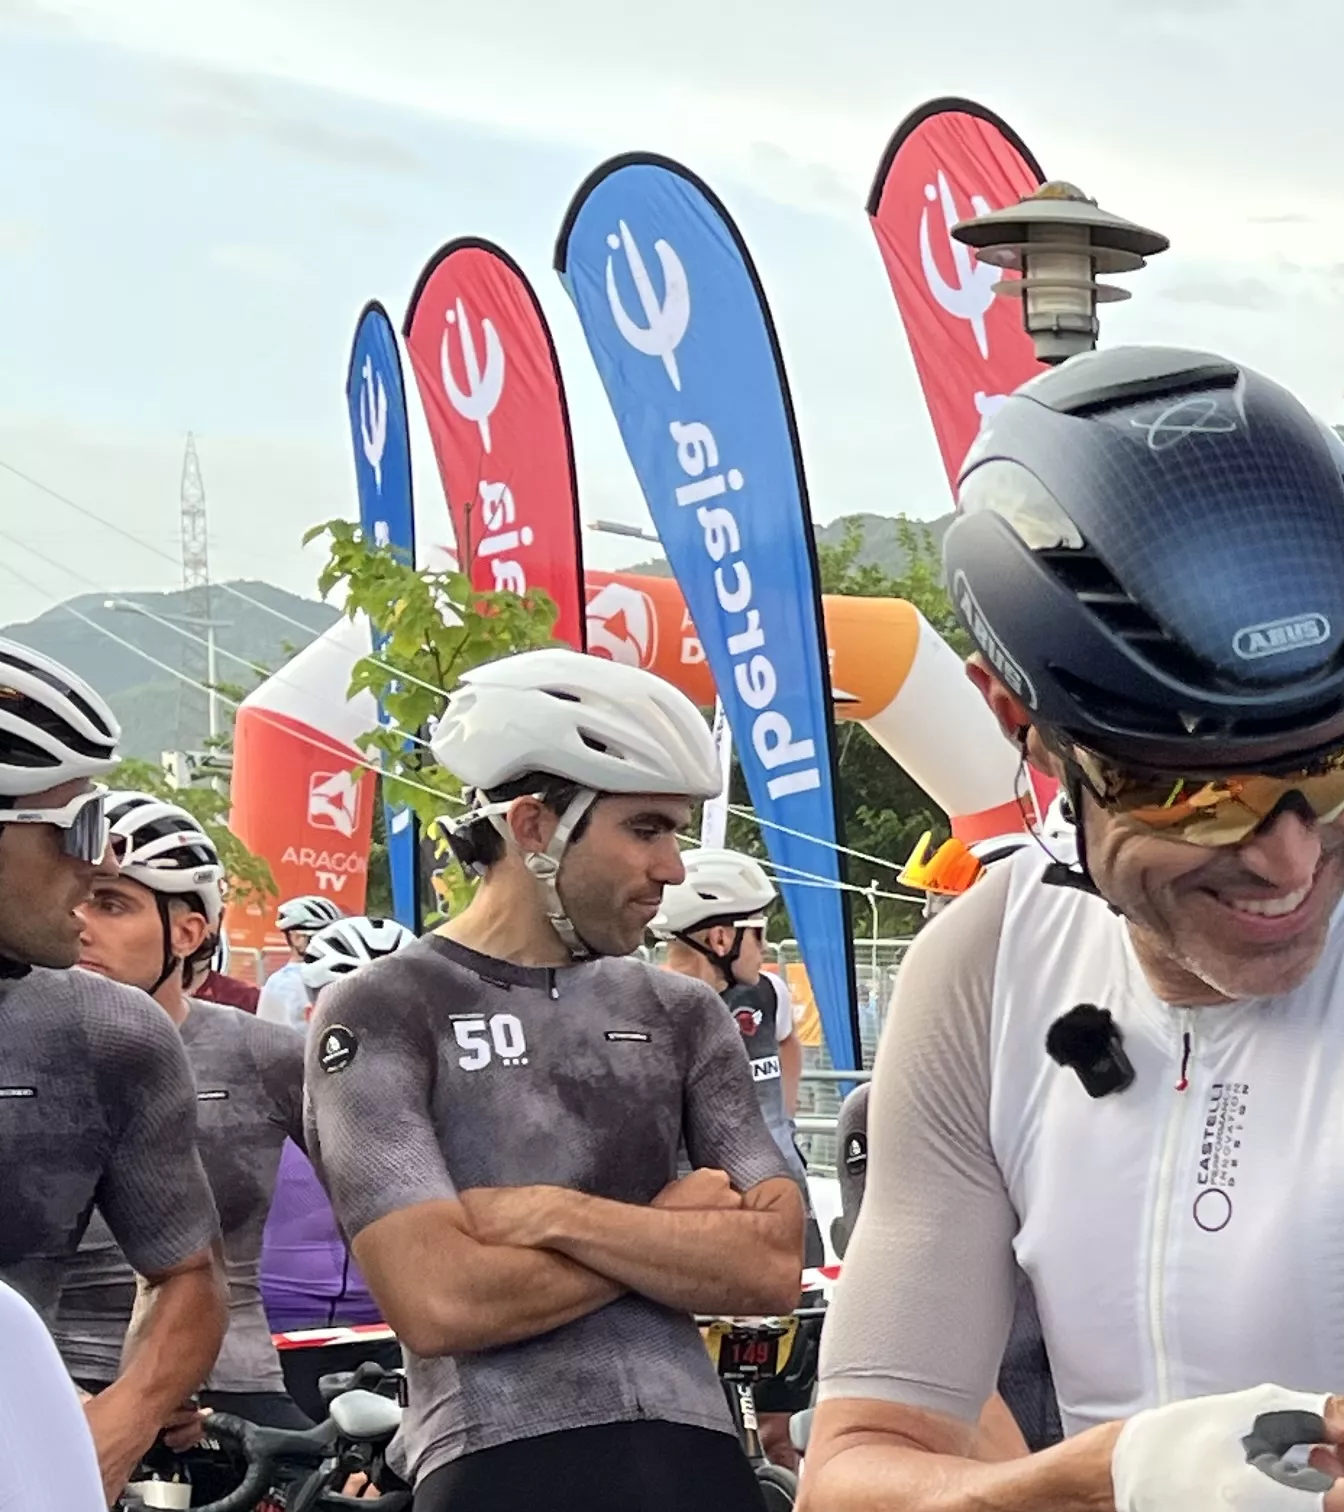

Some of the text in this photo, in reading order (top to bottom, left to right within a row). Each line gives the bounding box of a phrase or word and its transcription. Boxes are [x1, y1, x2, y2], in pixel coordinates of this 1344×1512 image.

[1248, 619, 1319, 653] ABUS
[315, 871, 348, 893] TV
[452, 1013, 528, 1072] 50
